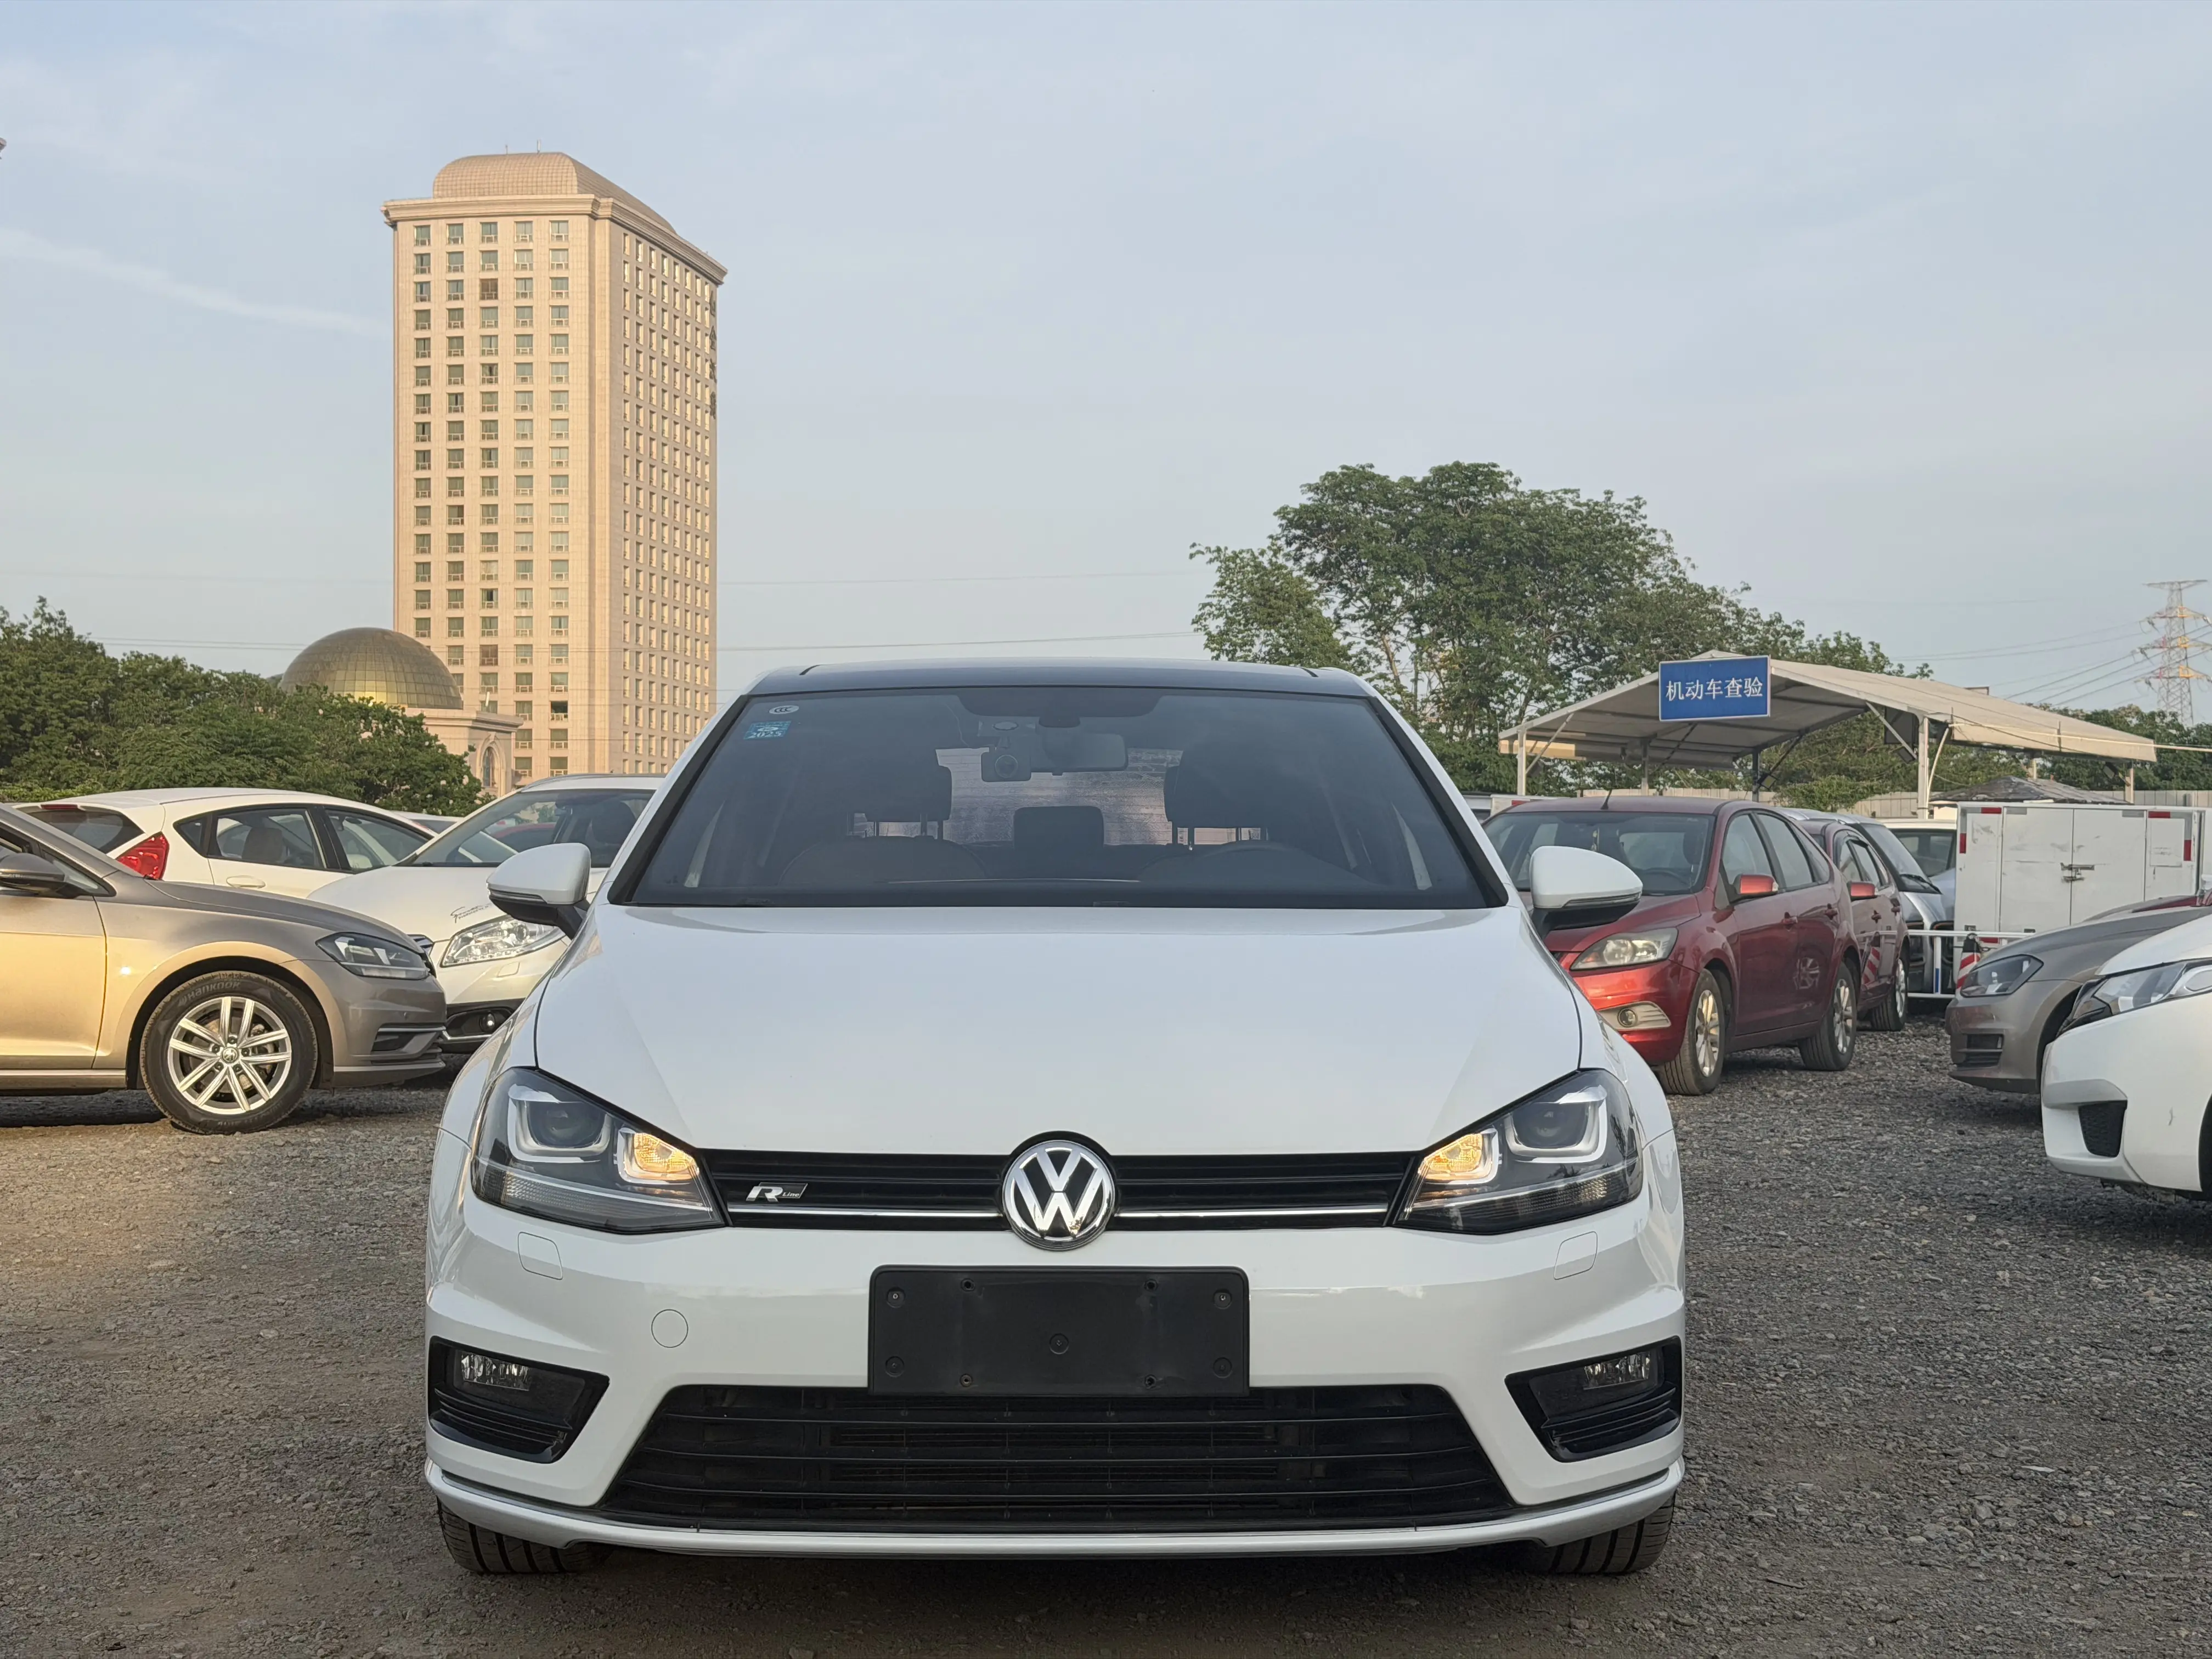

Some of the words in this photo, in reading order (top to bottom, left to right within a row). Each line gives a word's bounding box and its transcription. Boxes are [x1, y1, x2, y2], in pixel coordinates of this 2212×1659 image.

[1666, 676, 1763, 702] 机动车查验
[746, 1186, 783, 1202] R
